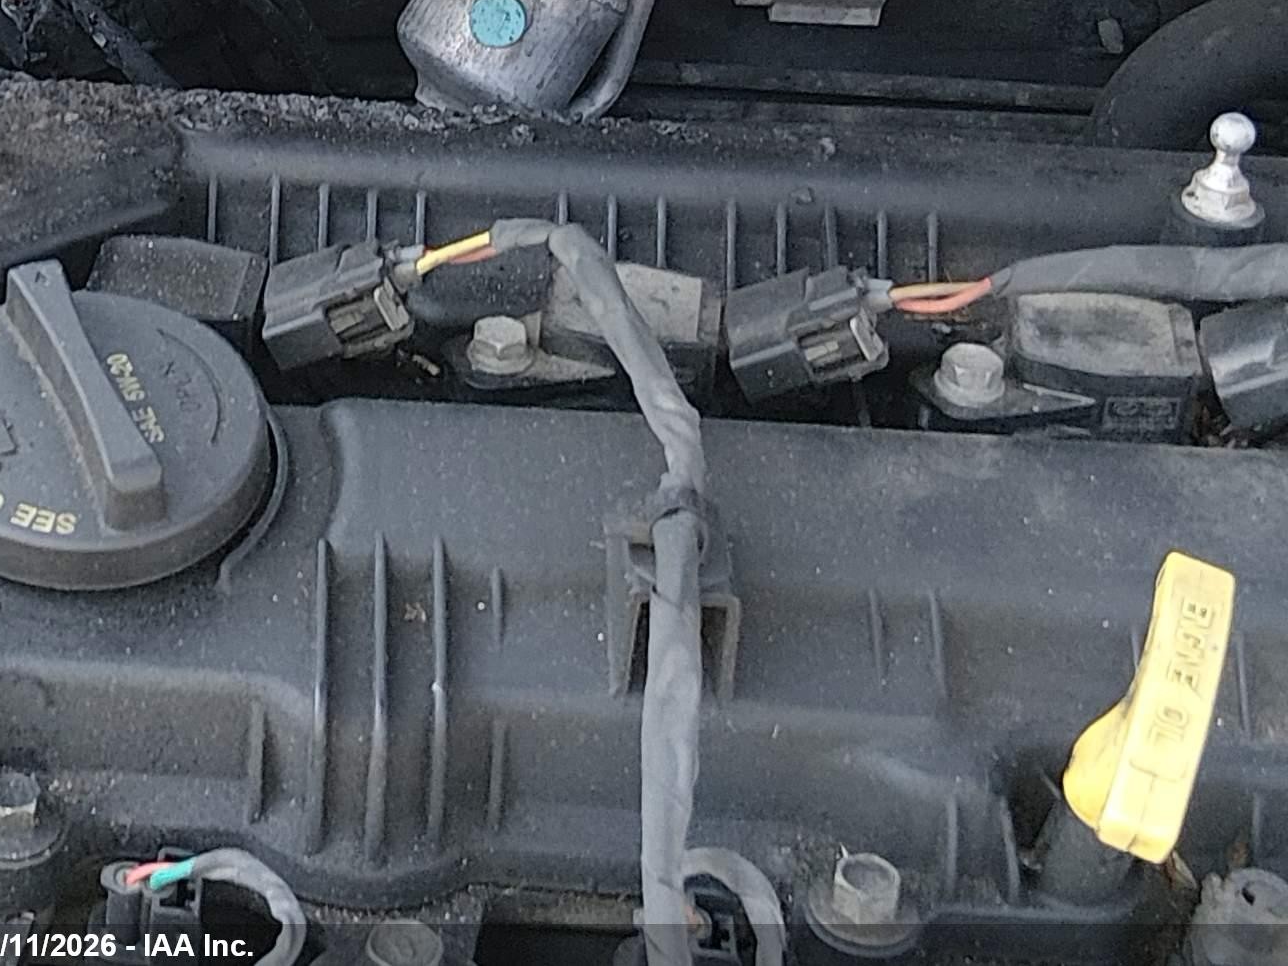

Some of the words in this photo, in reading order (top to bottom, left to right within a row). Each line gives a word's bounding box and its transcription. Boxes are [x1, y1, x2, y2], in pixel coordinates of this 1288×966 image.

[106, 353, 145, 402] 5W-20
[132, 407, 165, 443] SAE
[11, 503, 77, 534] SEE
